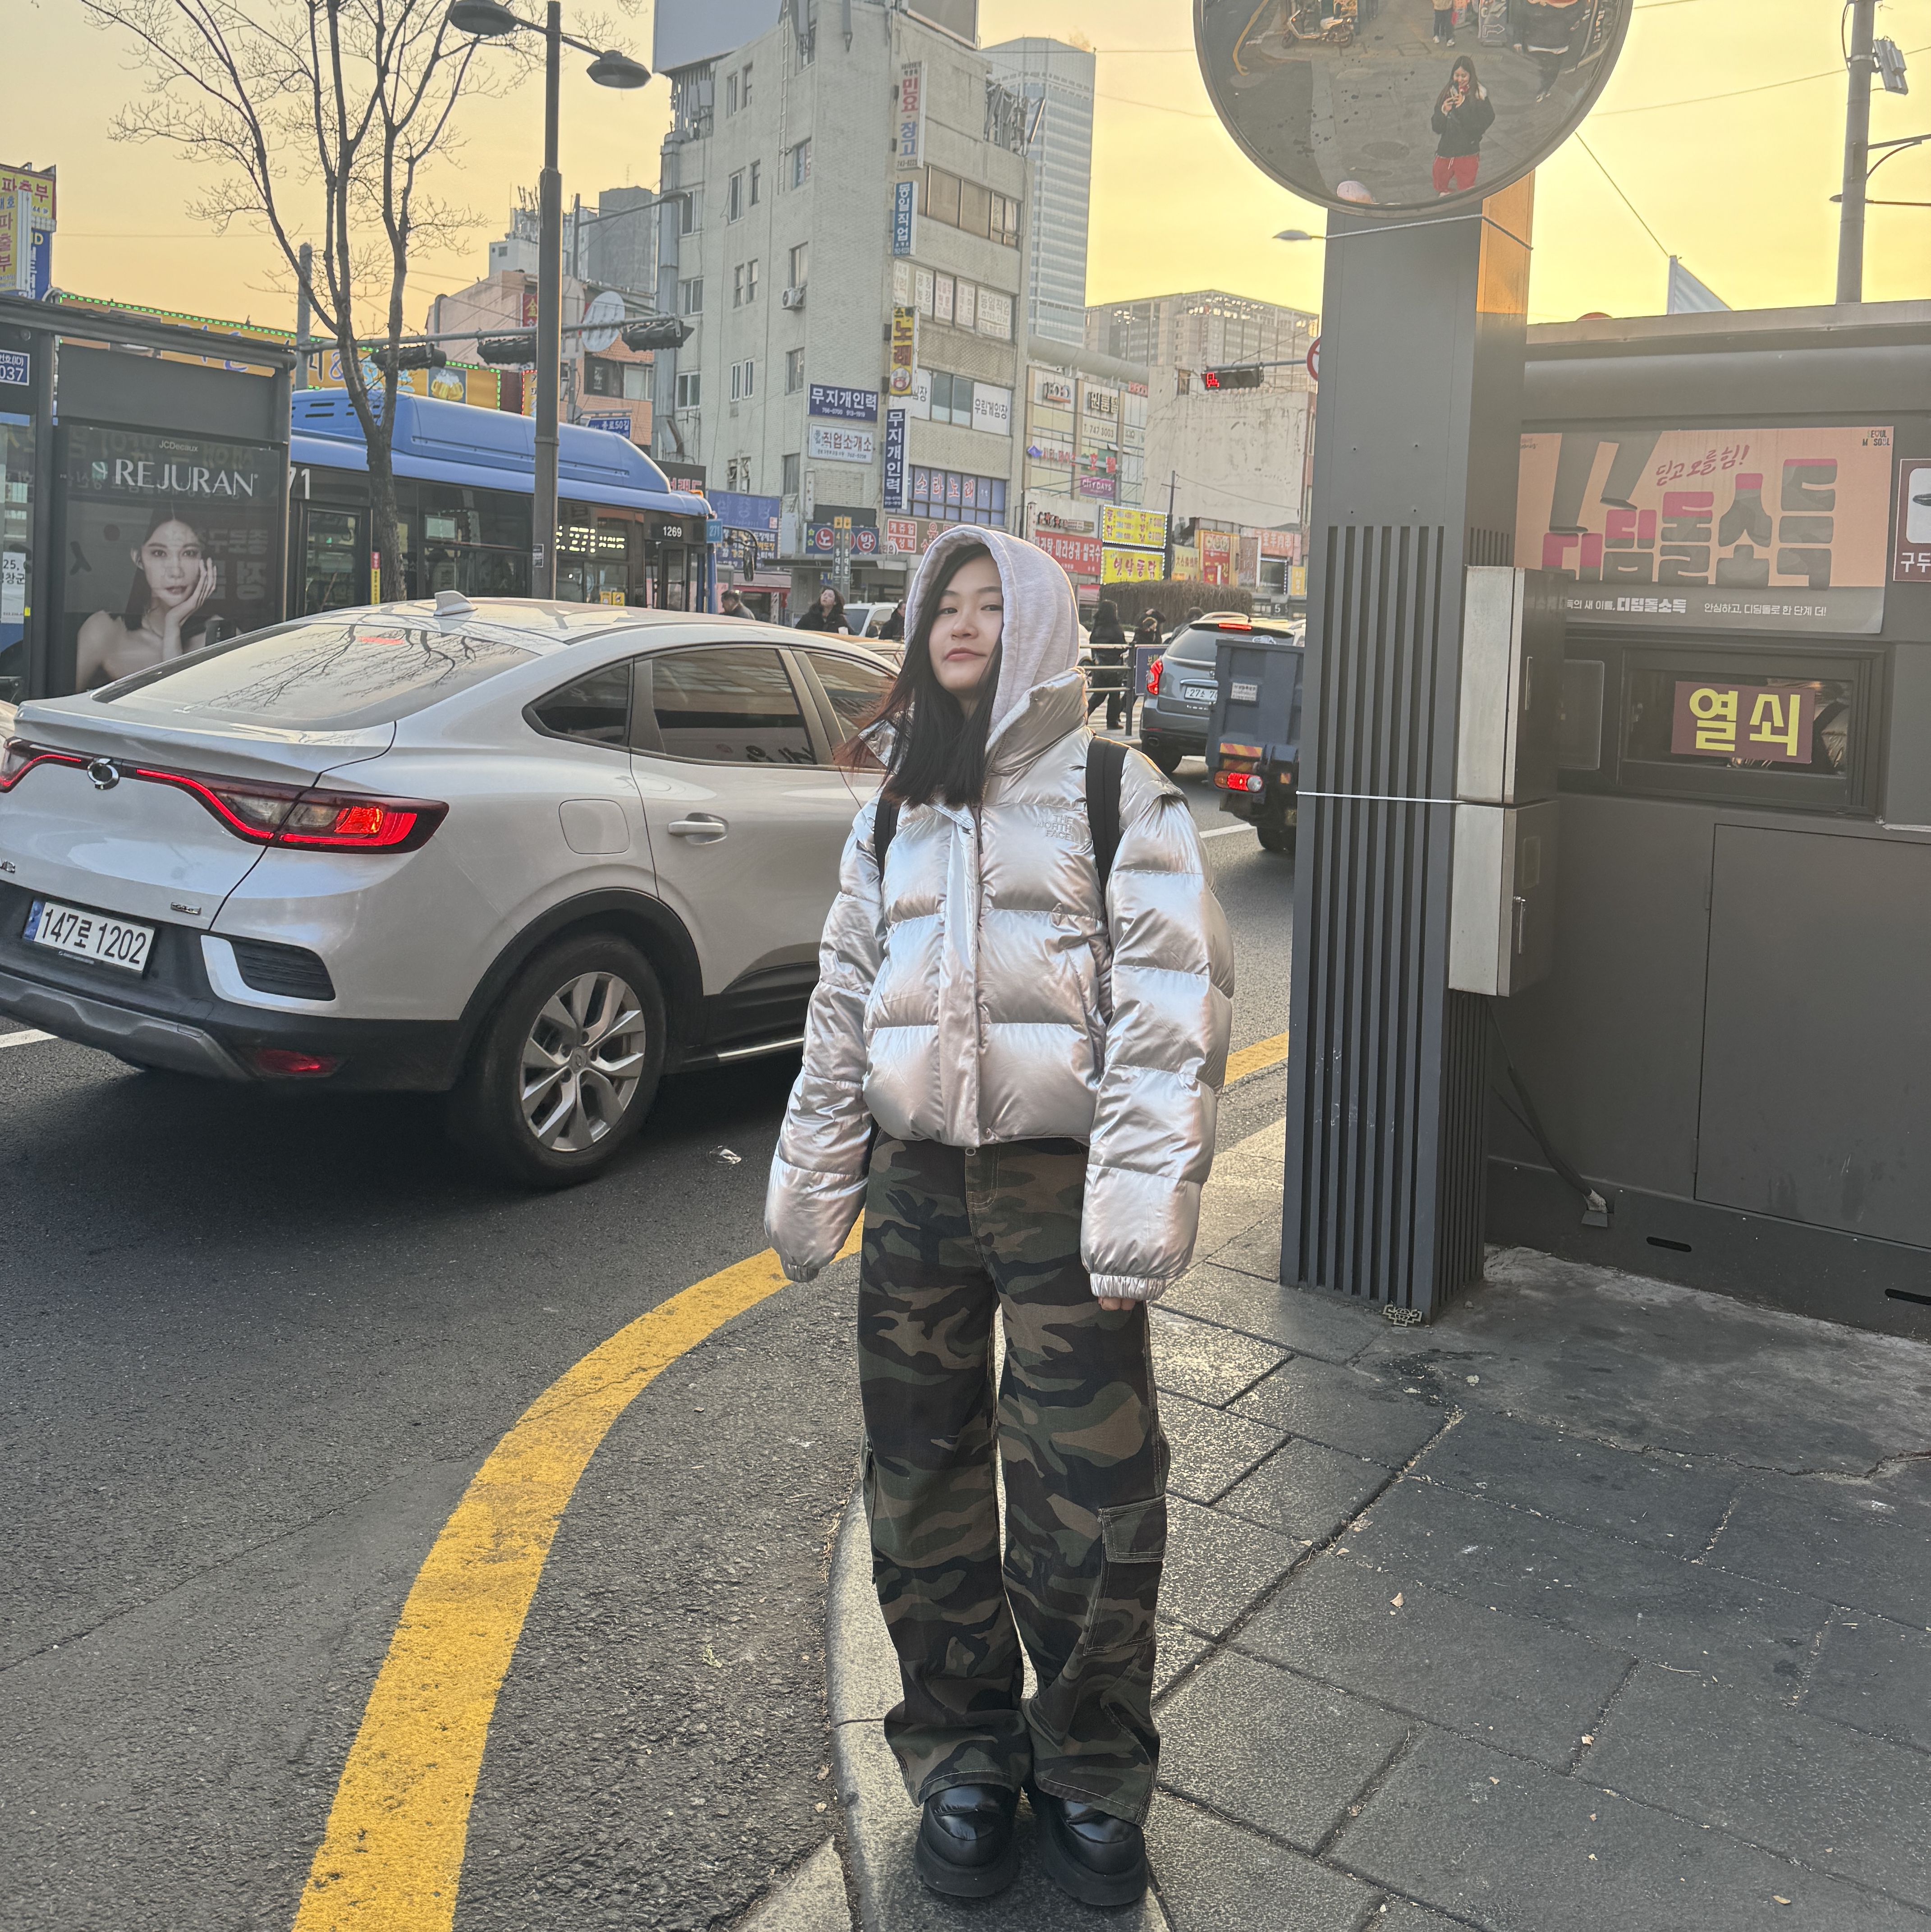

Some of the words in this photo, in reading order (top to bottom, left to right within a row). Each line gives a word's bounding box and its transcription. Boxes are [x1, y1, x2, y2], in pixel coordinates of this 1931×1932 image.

[901, 78, 918, 112] 민요
[899, 122, 917, 156] 장고
[897, 184, 910, 241] 동일직업
[894, 321, 913, 366] 노래
[812, 388, 877, 411] 무지개인력
[975, 399, 1008, 420] 우림게임장
[159, 440, 198, 452] JCDecaux
[823, 431, 871, 452] 직업소개소
[886, 412, 904, 493] 무지개인력
[1873, 438, 1890, 446] SOUL
[1656, 460, 1685, 486] 딛고
[1686, 449, 1716, 477] 오를
[1720, 444, 1750, 470] 힘!
[115, 459, 255, 497] REJURAN
[915, 473, 975, 504] 스타노래
[663, 526, 682, 537] 1269
[709, 525, 720, 537] 271
[1542, 459, 1837, 591] 디딤돌소득
[1900, 552, 1931, 573] 구두
[1585, 600, 1593, 610] 새
[1617, 597, 1687, 614] 디딤돌소득
[1705, 603, 1742, 614] 안심하고,
[1783, 606, 1793, 615] 한
[1794, 606, 1812, 616] 단계
[1815, 606, 1827, 616] 더!
[1689, 688, 1801, 757] 열쇠
[1037, 821, 1073, 833] NORTH
[1052, 814, 1073, 824] THE
[1046, 830, 1074, 841] FACE
[42, 909, 92, 948] 147로
[96, 923, 147, 964] 1202
